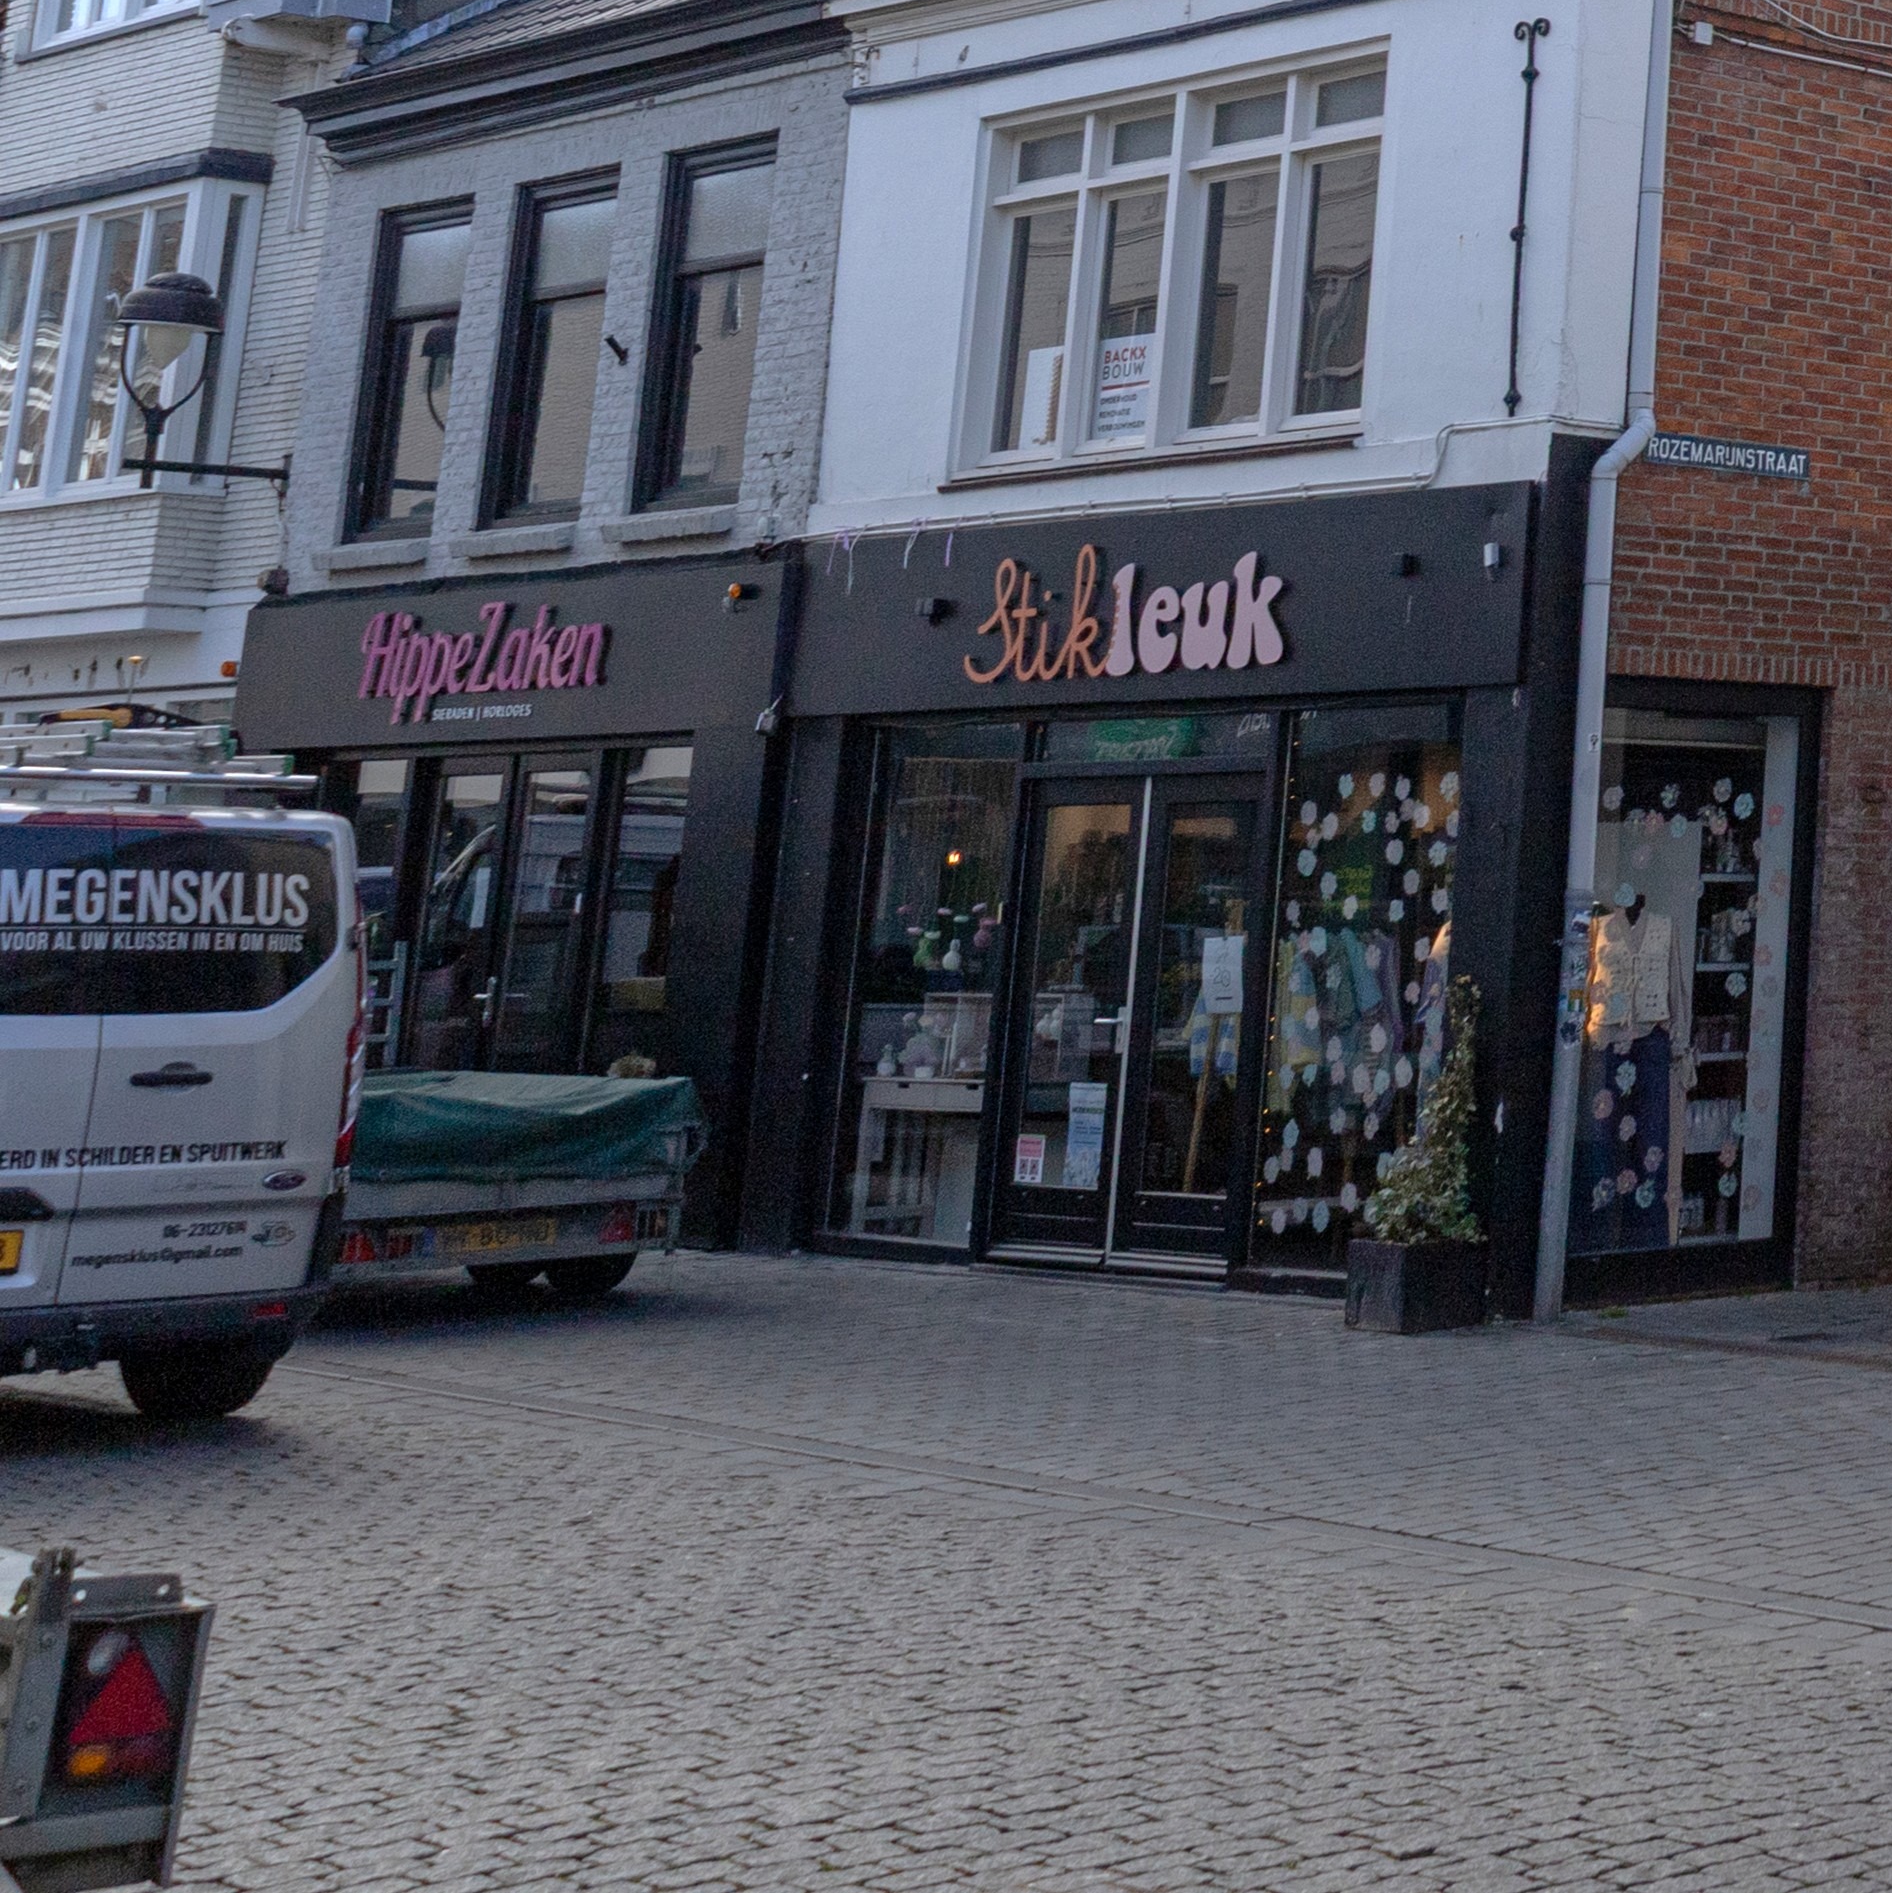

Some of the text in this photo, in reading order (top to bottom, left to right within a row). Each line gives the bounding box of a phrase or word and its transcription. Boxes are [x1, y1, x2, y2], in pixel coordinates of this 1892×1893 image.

[1104, 346, 1147, 364] BACKX
[1102, 361, 1144, 380] BOUW
[1648, 437, 1807, 474] ROZEMARIJNSTRAAT
[432, 704, 532, 721] SIERADEN HORLOGES
[0, 868, 311, 927] MEGENSKLUS
[1, 931, 304, 953] VOOR AL UW KLUSSEN IN EN OM HUIS
[41, 1149, 59, 1168] IN
[65, 1145, 155, 1168] SCHILDER
[159, 1144, 184, 1164] EN
[188, 1140, 289, 1162] SPUITWERK
